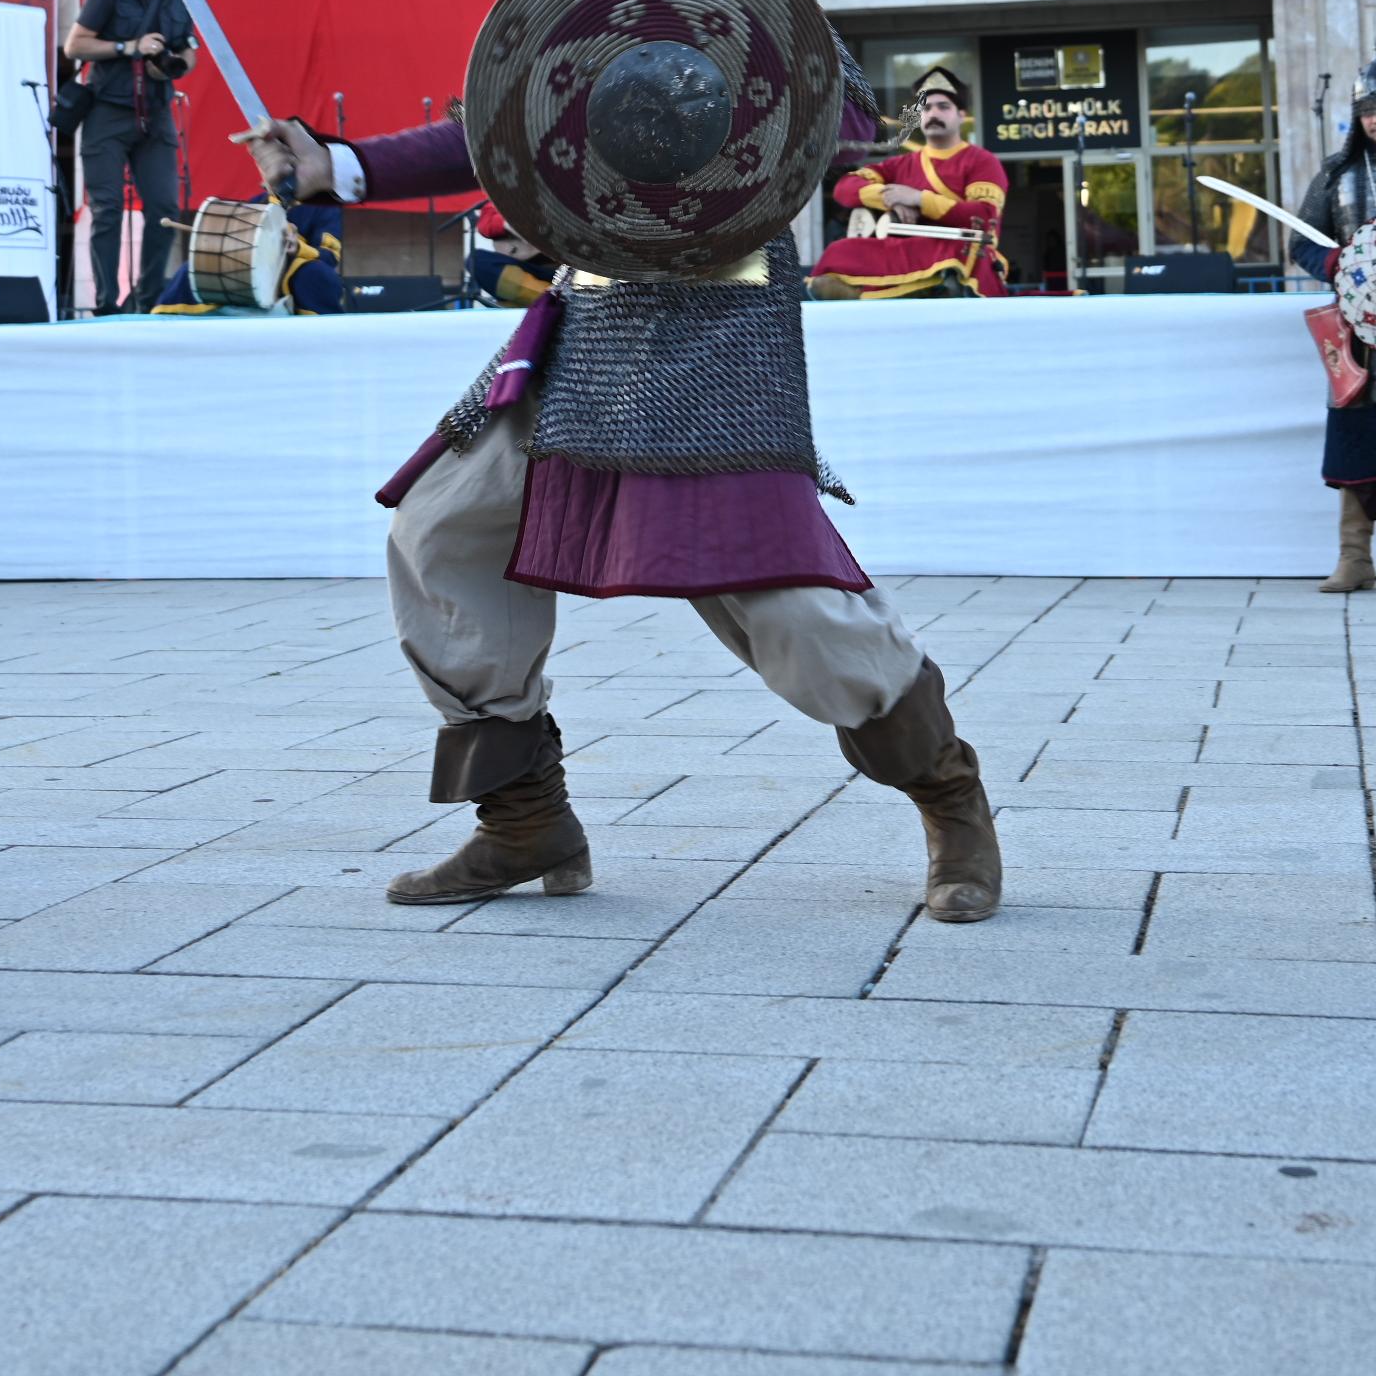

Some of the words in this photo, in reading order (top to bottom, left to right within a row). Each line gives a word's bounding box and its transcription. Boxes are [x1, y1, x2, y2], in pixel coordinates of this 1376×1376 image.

[1002, 98, 1122, 120] DÂRÜLMÜLK
[997, 120, 1055, 140] SERGİ
[1058, 119, 1129, 138] SARAYI
